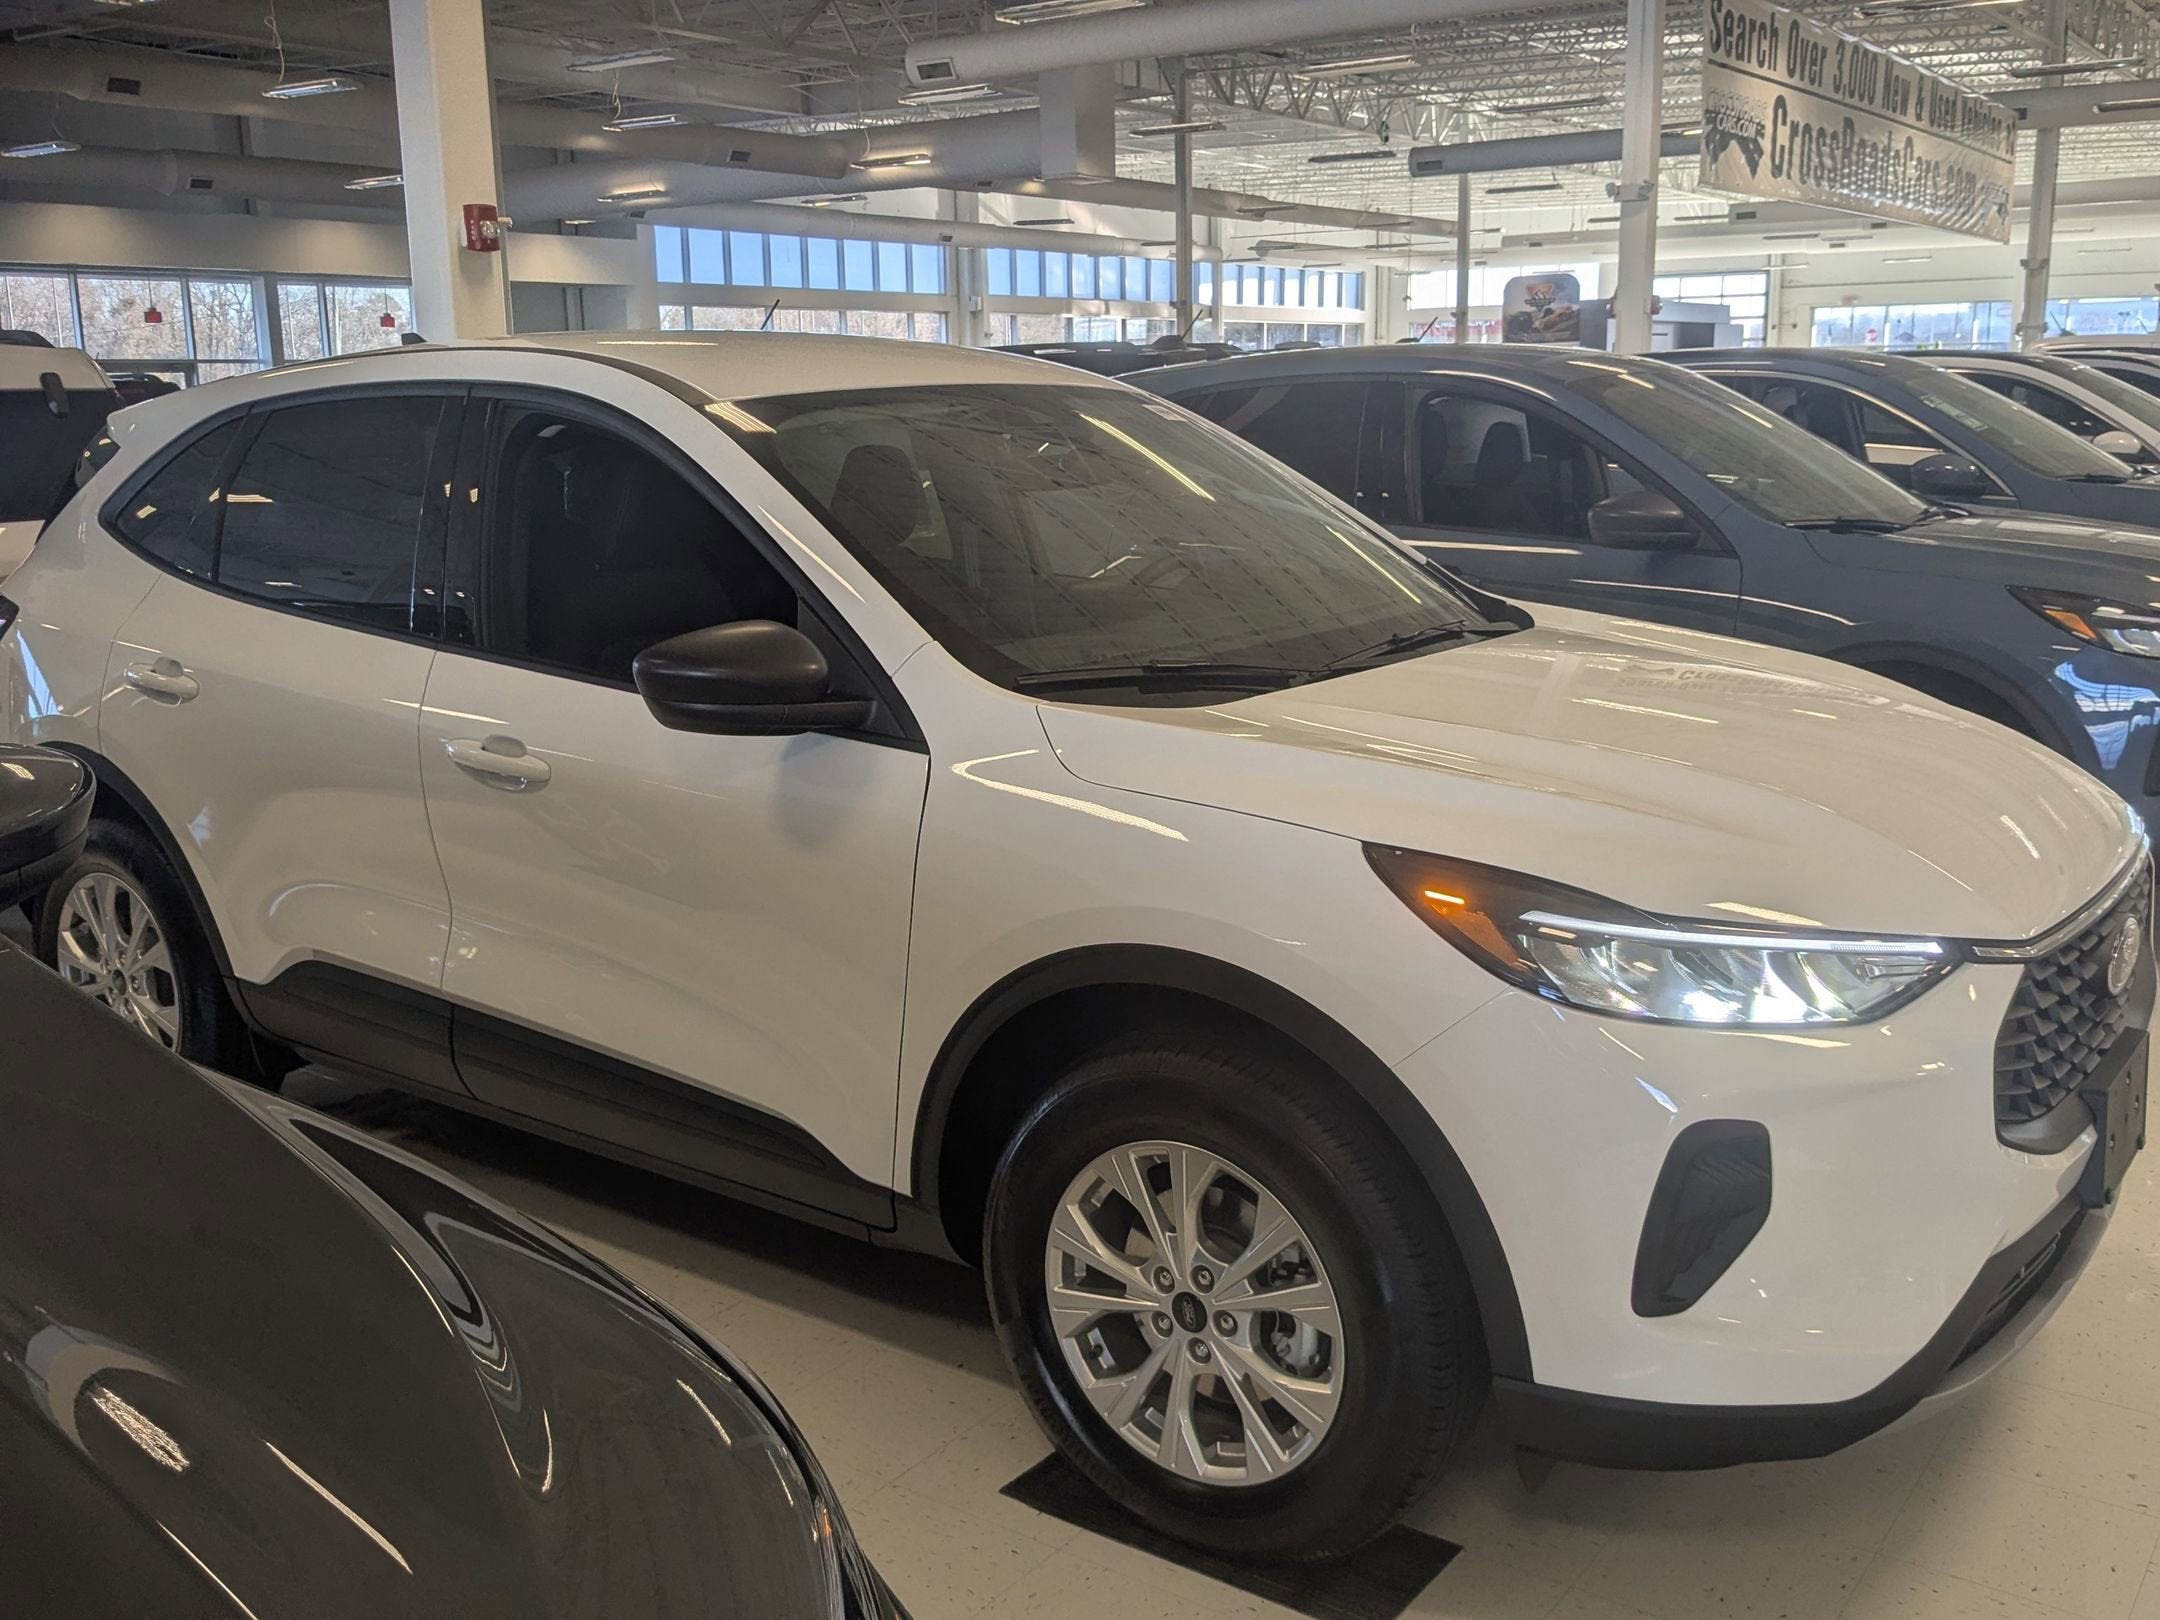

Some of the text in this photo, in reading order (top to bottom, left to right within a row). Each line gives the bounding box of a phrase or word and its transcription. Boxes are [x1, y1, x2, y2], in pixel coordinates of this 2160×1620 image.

[1708, 1, 1779, 72] Search
[1786, 19, 1828, 88] Over
[1833, 38, 1878, 105] 3,000
[1882, 58, 1911, 117] New
[1915, 75, 1925, 122] &
[1929, 79, 1958, 132] Used
